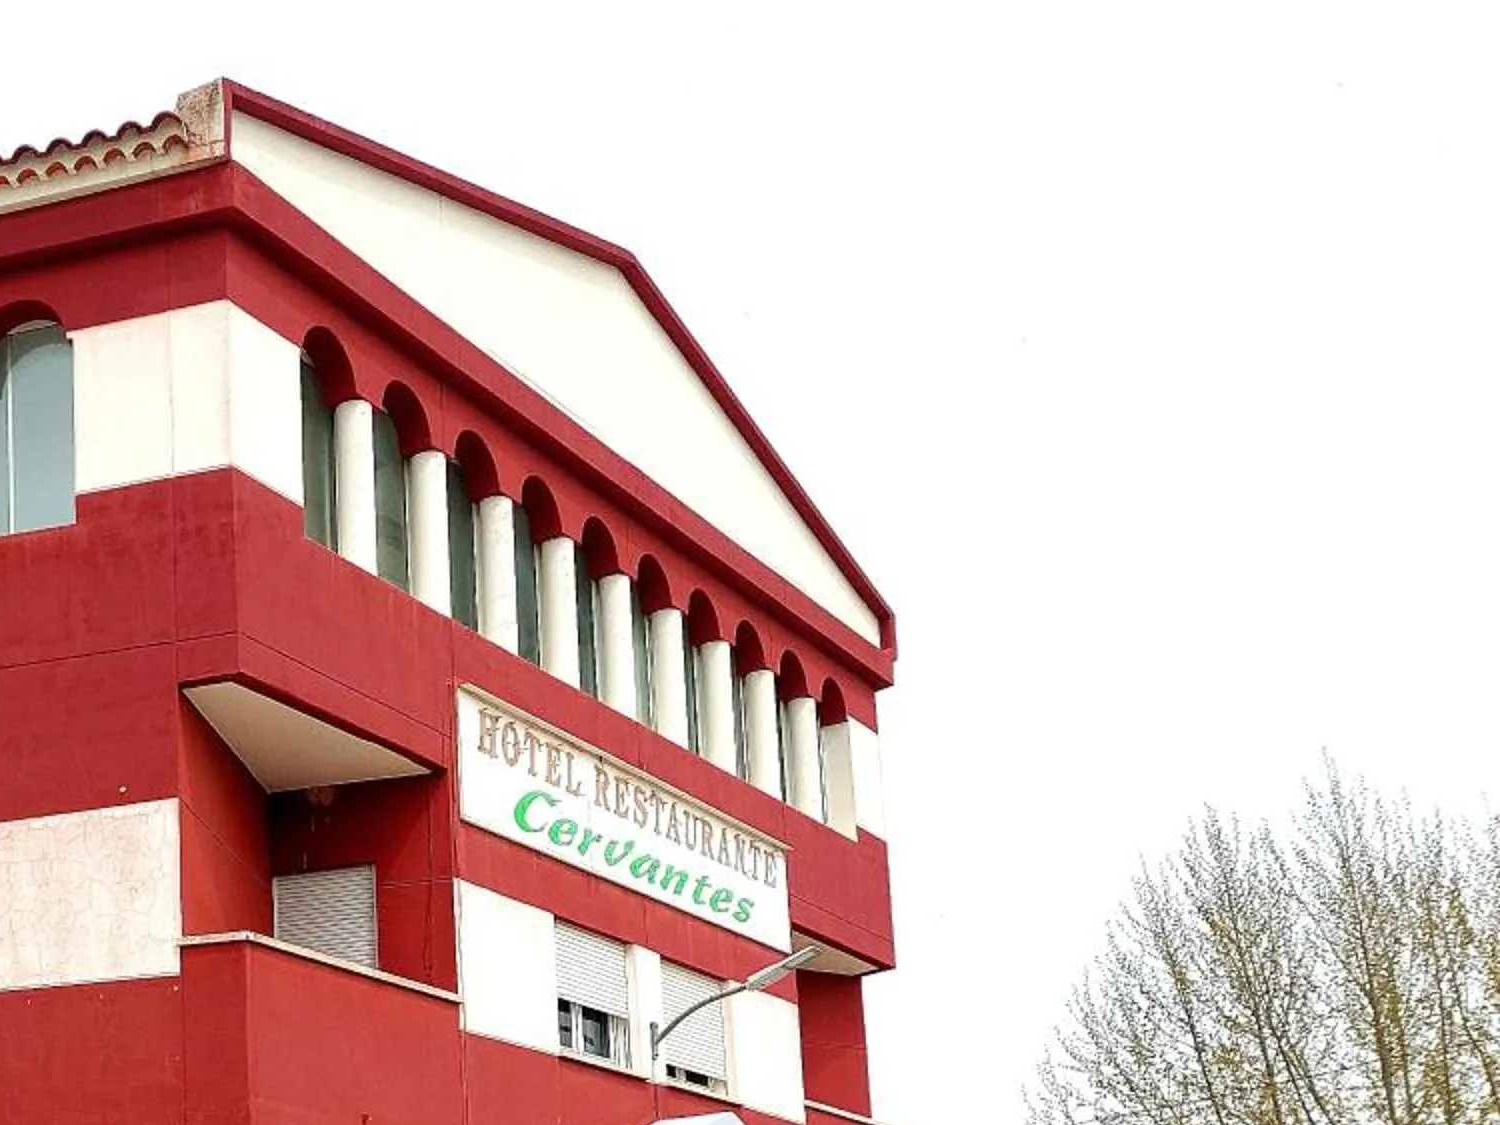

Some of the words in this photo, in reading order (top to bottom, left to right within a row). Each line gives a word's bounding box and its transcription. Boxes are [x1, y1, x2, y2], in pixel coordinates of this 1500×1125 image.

[477, 707, 586, 797] HOTEL
[594, 761, 778, 888] RESTAURANTE
[513, 791, 755, 923] Cervantes
